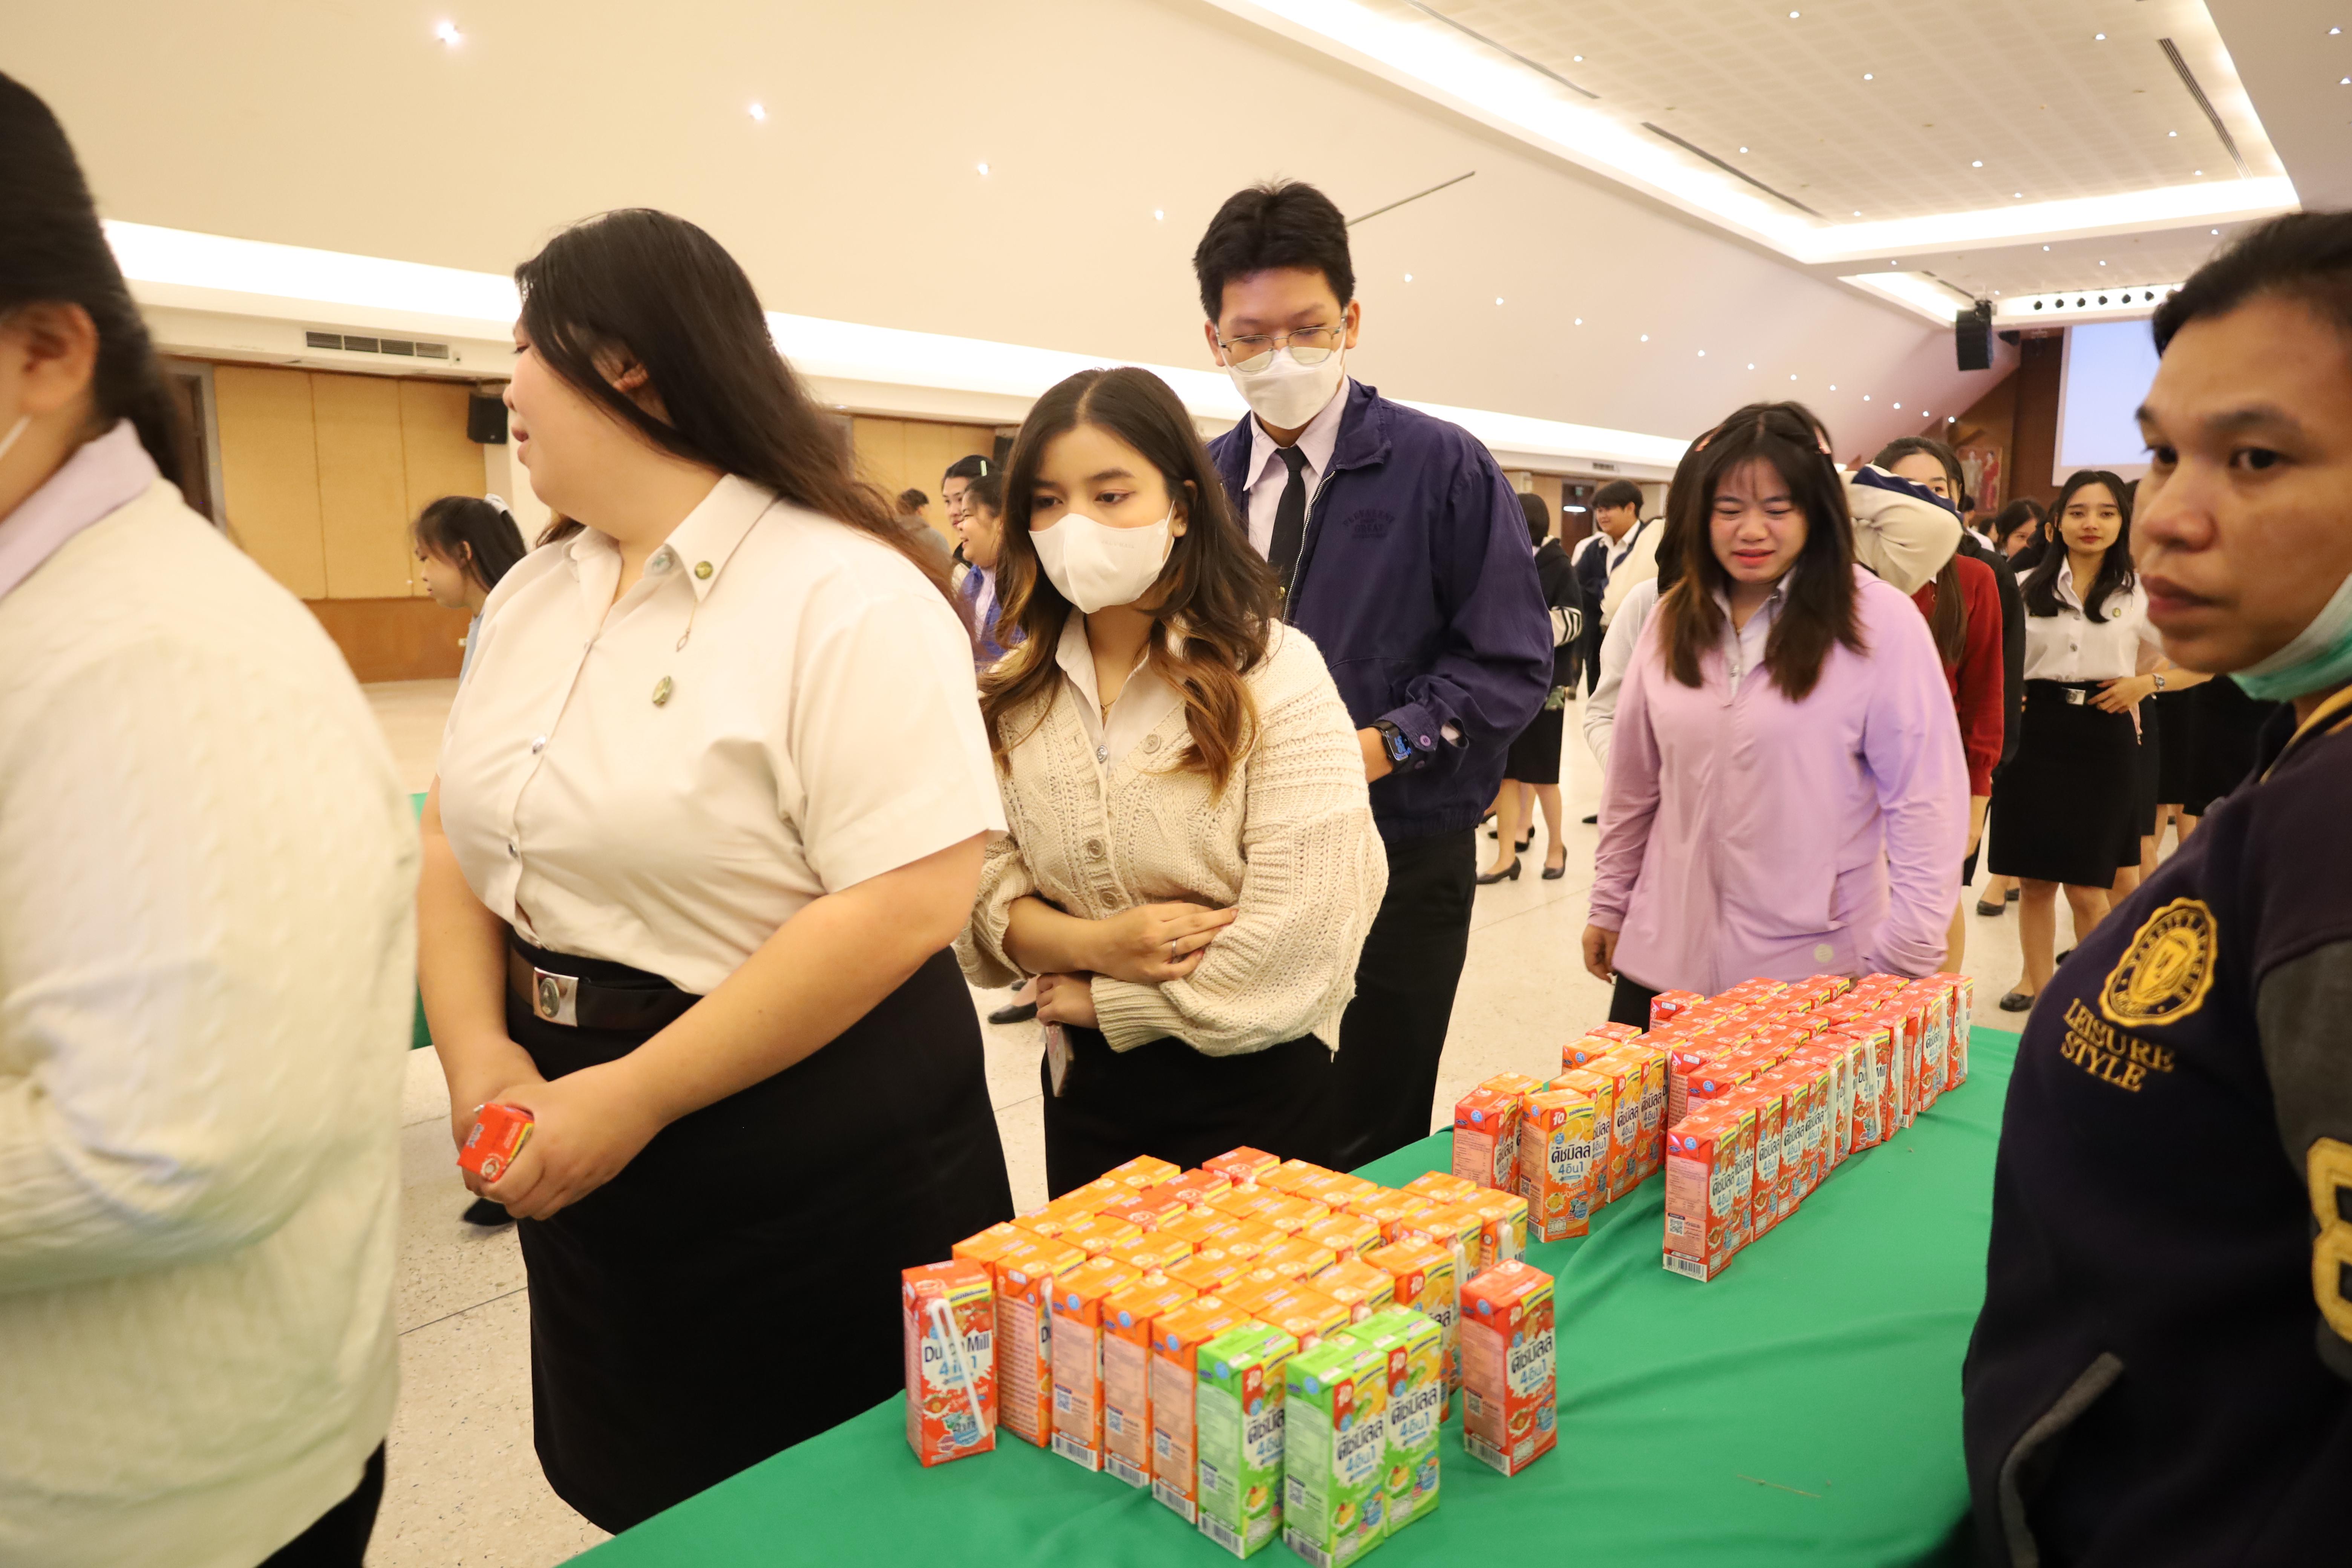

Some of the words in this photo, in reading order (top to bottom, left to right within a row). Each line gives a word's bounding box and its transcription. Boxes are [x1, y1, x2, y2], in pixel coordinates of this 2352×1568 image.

[2060, 1031, 2147, 1092] STYLE
[1551, 1141, 1591, 1163] ดัชมิลล์
[1712, 1172, 1734, 1196] ดัชมิลล
[925, 1342, 965, 1362] Duc
[968, 1334, 989, 1352] Mill
